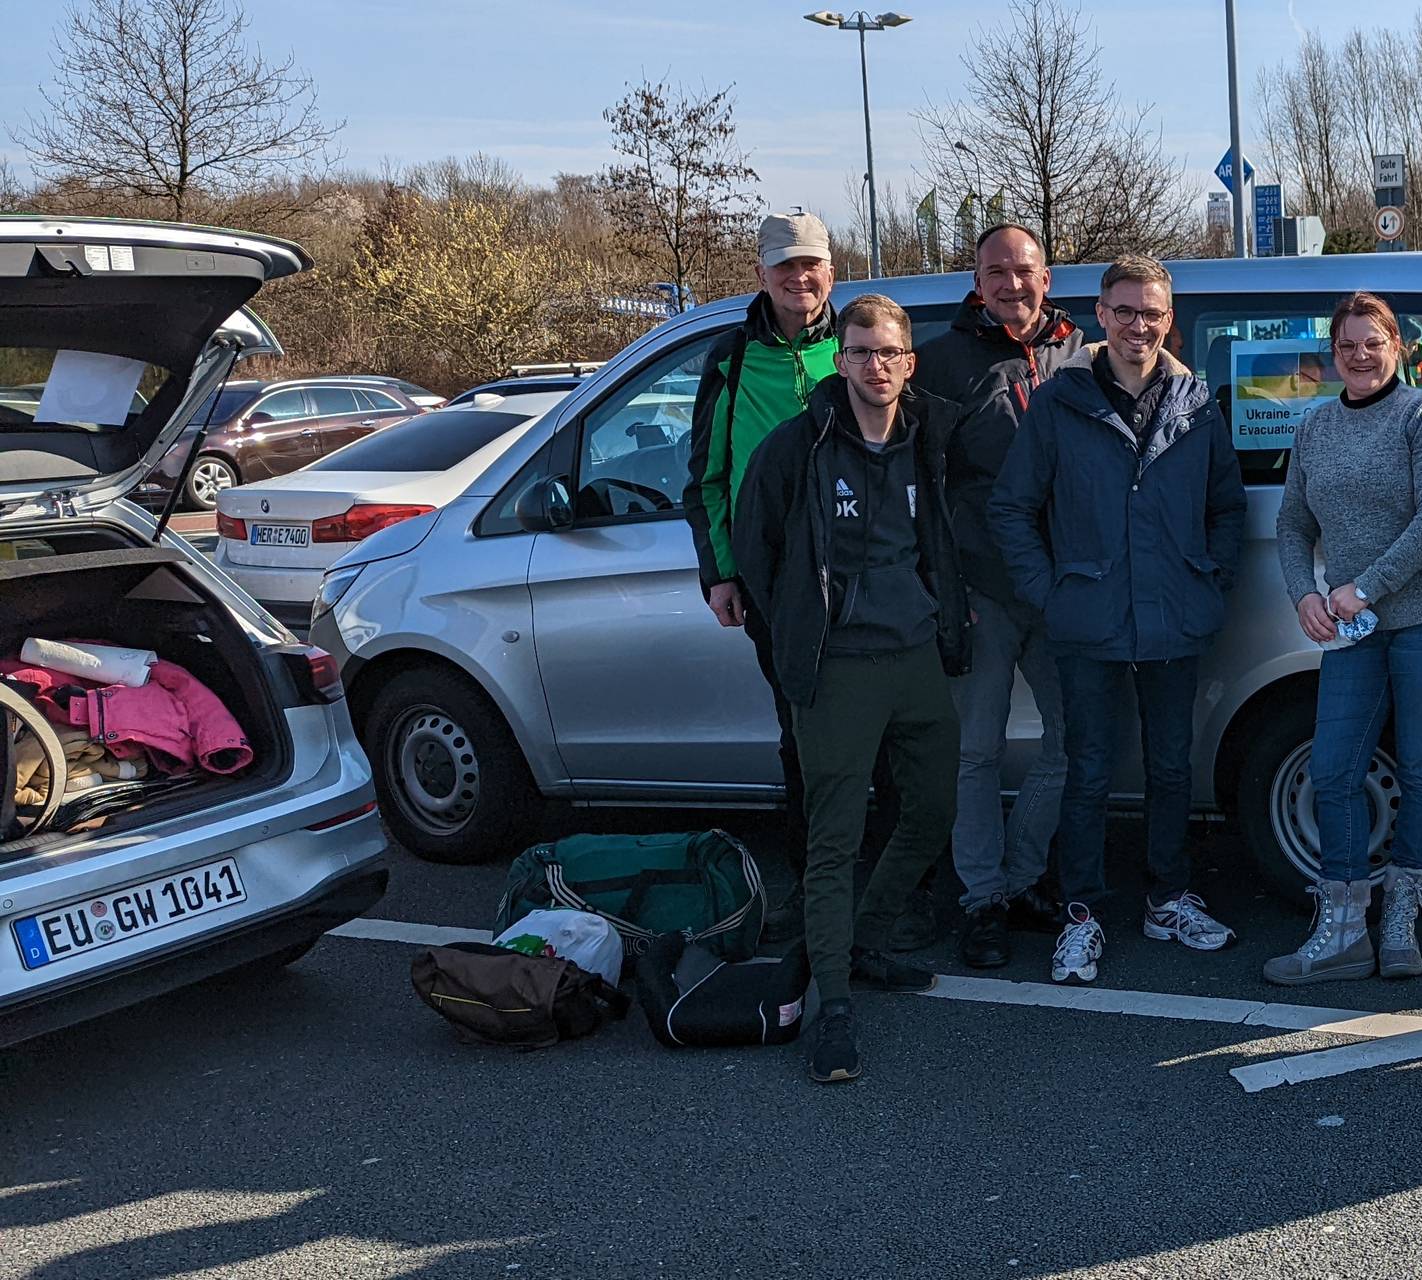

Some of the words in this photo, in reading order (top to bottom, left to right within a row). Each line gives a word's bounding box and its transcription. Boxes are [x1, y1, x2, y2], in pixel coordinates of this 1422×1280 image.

[1380, 159, 1396, 169] Gute
[1378, 172, 1398, 183] Fahrt
[1246, 408, 1290, 420] Ukraine
[1239, 423, 1298, 436] Evacuatio
[257, 527, 273, 543] HER
[42, 909, 94, 956] EU
[112, 888, 158, 933] GW
[161, 865, 242, 919] 1041
[30, 947, 40, 960] D
